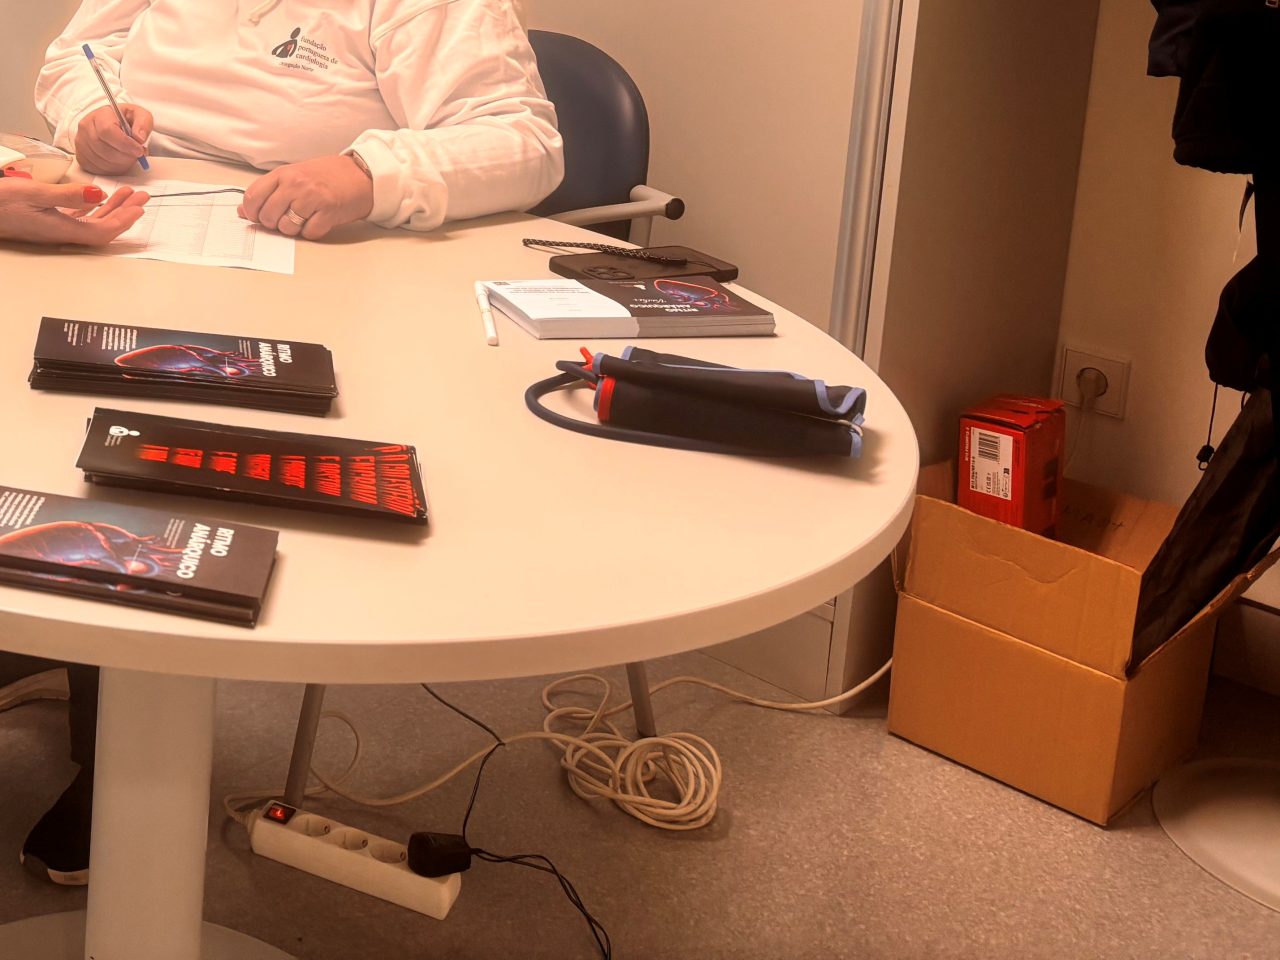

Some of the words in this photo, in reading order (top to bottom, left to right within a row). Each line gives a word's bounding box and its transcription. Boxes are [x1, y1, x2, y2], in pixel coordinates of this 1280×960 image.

[276, 343, 293, 364] RITMO
[176, 522, 212, 579] ANÁRQUICO
[210, 527, 235, 557] RITMO
